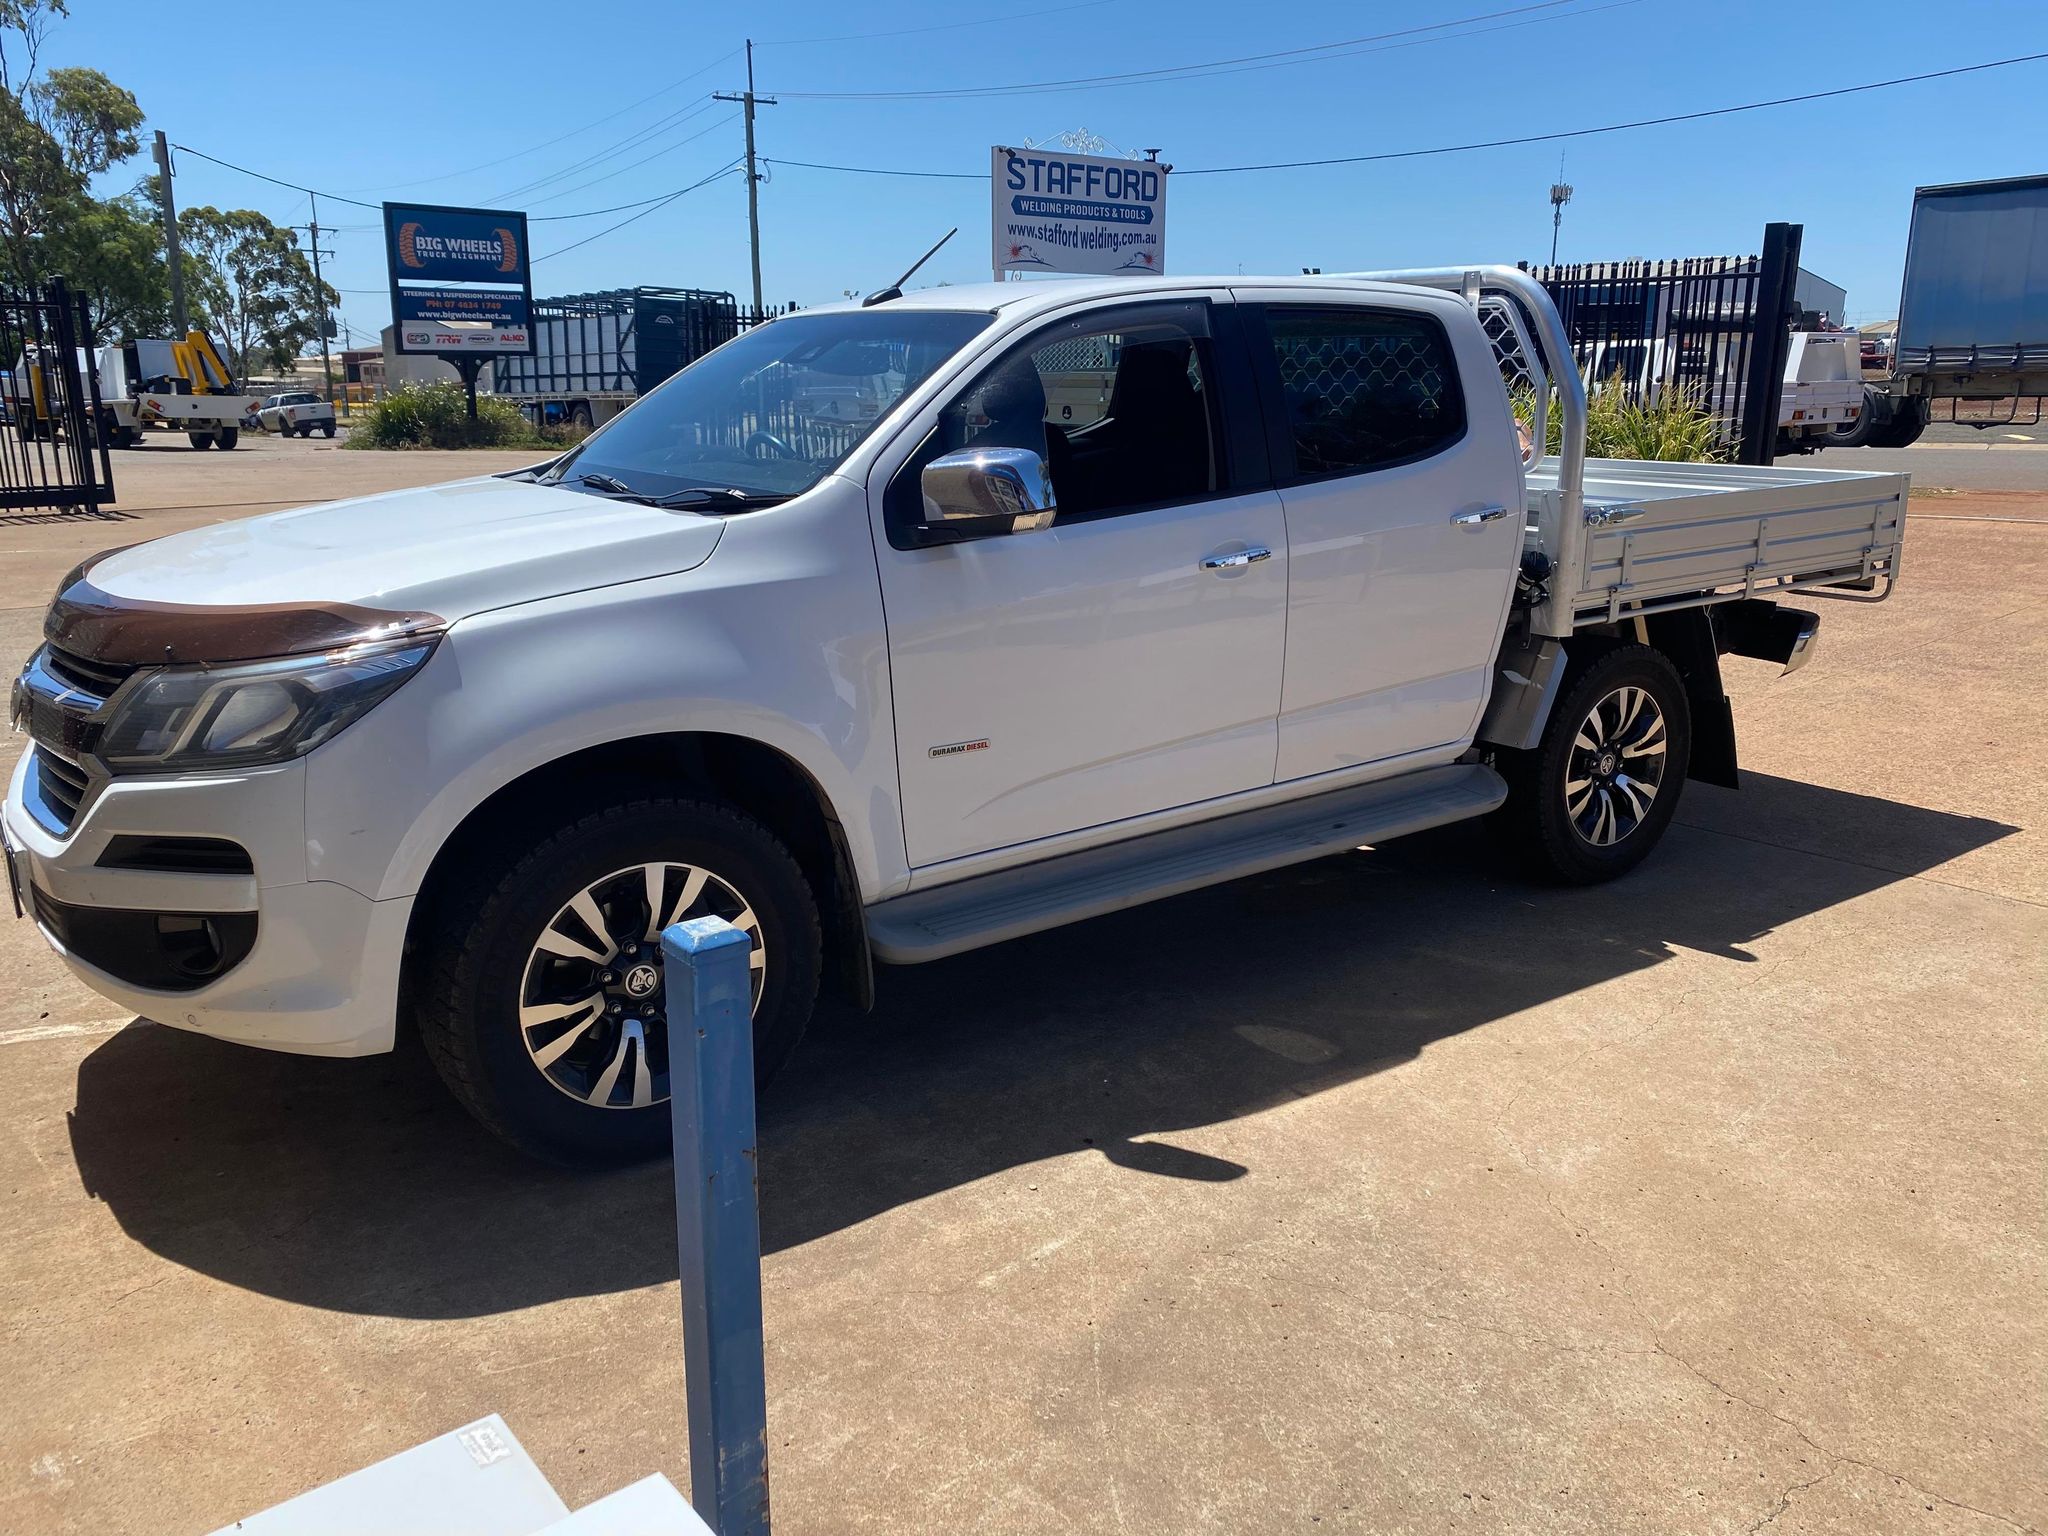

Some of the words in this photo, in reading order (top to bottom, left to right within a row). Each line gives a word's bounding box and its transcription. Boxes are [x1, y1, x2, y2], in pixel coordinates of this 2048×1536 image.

[1007, 157, 1158, 201] STAFFORD
[1020, 200, 1062, 214] WELDING
[1063, 203, 1110, 218] PRODUCTS
[1111, 208, 1118, 218] &
[1119, 208, 1146, 220] TOOLS
[415, 236, 442, 250] BIG
[444, 238, 502, 254] WHEELS
[416, 250, 447, 259] TRUCK
[451, 252, 502, 261] ALIGNMENT
[403, 290, 435, 298] STEERING
[443, 291, 483, 300] SUSPENSION
[483, 293, 522, 301] SPECIALISTS
[444, 300, 456, 309] 07
[417, 311, 512, 320] www.bigwheels.net.au
[435, 334, 463, 344] TRW
[932, 745, 965, 756] DURAMAX
[967, 741, 988, 751] DIESEL
